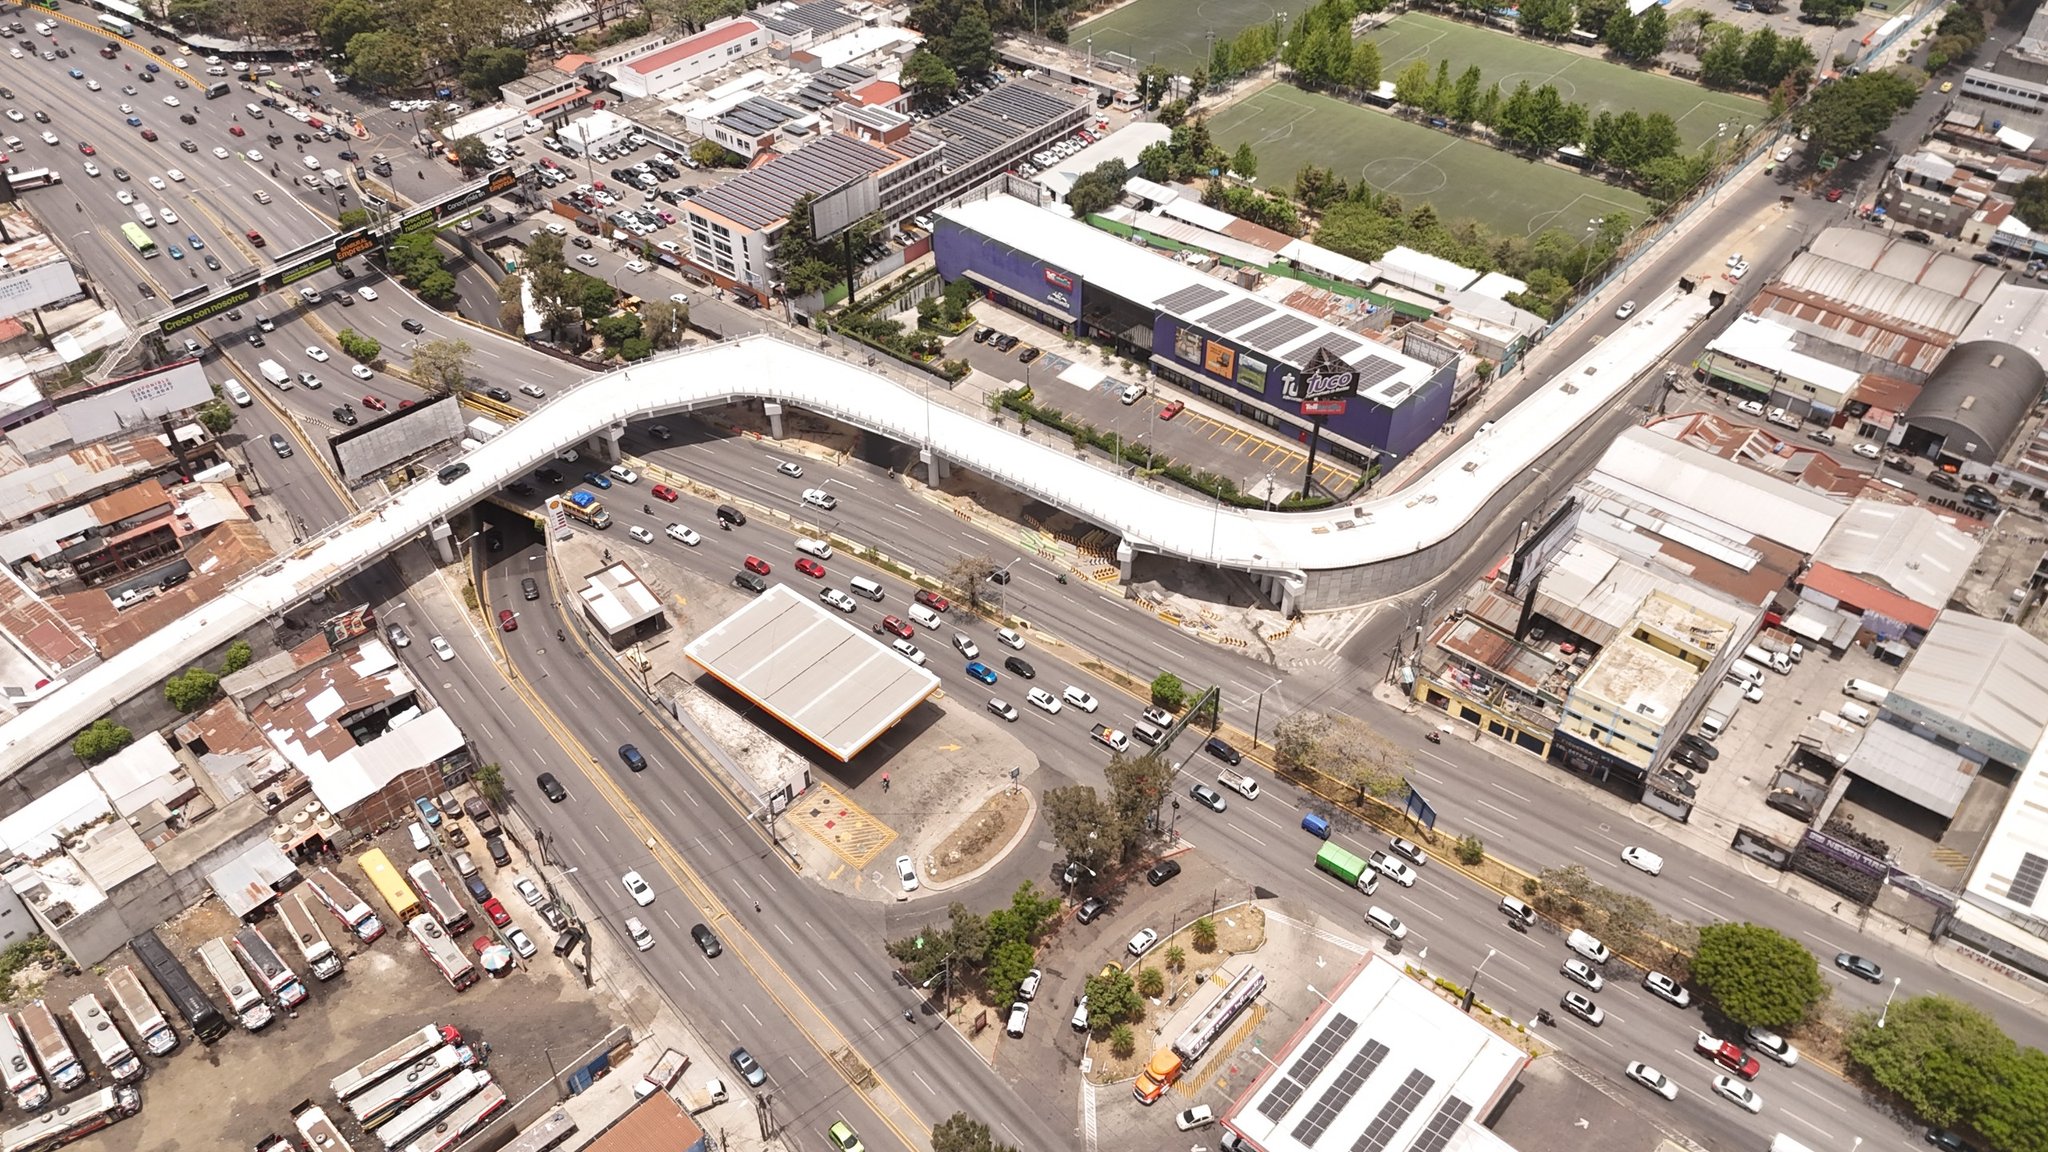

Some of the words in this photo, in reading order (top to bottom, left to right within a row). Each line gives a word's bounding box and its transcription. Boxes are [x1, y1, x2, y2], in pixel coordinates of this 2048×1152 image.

[403, 215, 420, 226] Crece
[420, 210, 433, 220] con
[404, 216, 434, 232] nosotros
[336, 242, 373, 260] Empresas
[164, 315, 193, 331] Crece
[193, 307, 211, 319] con
[211, 291, 250, 313] nosotros
[130, 378, 169, 395] DISPONIBLE
[1306, 369, 1353, 395] tuco
[1825, 839, 1861, 862] NEXEN
